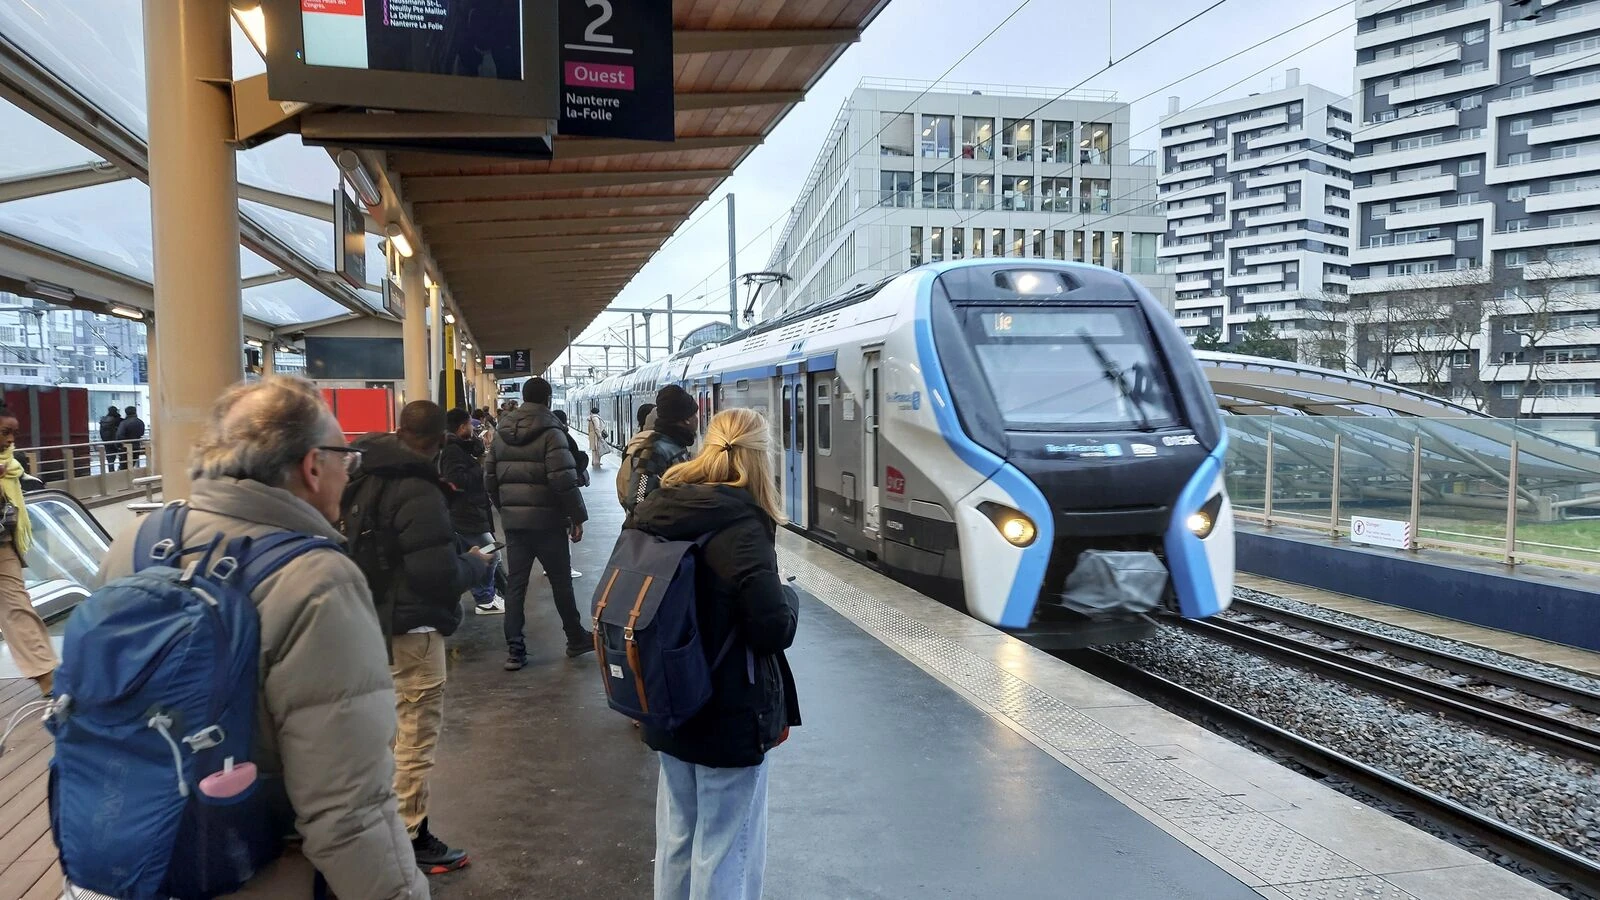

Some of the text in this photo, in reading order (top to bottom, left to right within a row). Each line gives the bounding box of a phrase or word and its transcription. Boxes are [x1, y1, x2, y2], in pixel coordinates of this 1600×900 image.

[389, 3, 447, 16] Neuilly Pte Maillot
[389, 11, 425, 21] La Défense
[390, 18, 444, 31] Nanterre La Folie
[584, 0, 614, 44] 2
[574, 65, 626, 85] Ouest
[566, 92, 620, 108] Nanterre
[566, 106, 613, 121] la-Folie
